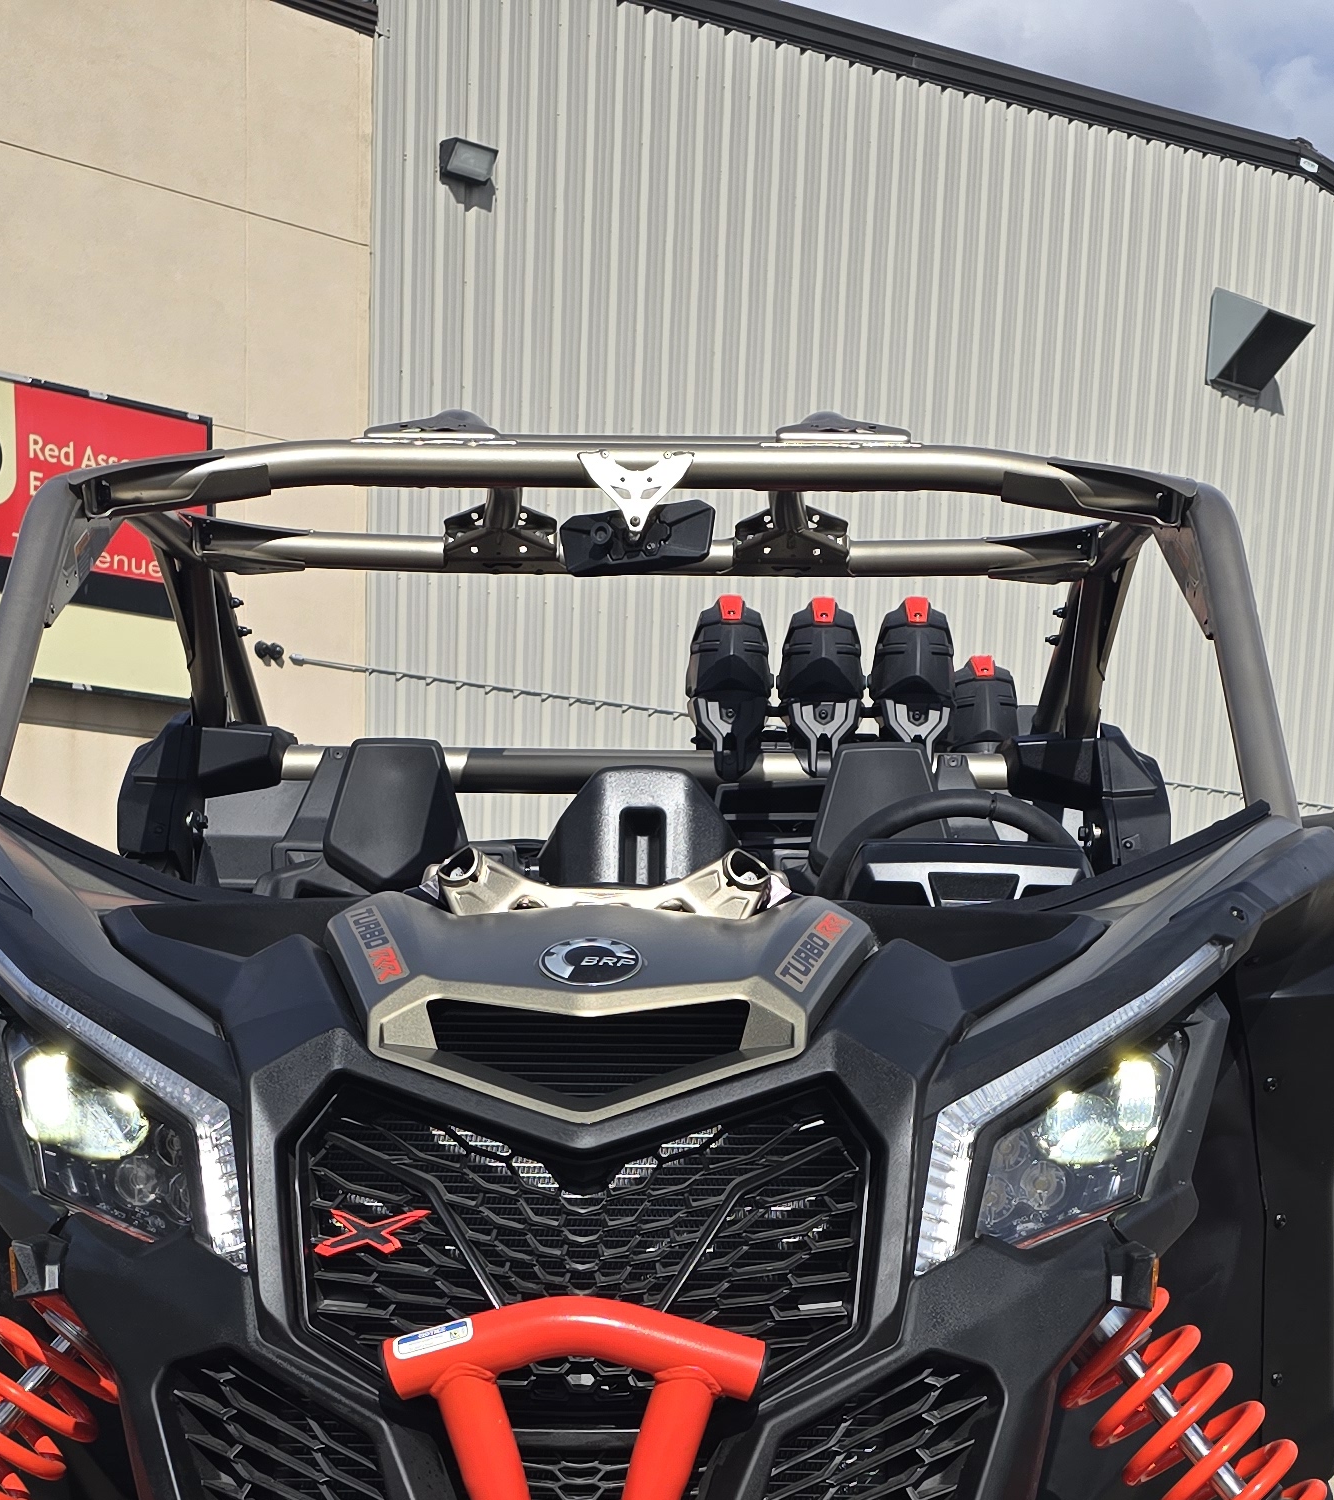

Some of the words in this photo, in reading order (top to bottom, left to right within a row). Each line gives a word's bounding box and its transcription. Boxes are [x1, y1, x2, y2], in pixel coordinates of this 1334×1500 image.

[28, 433, 74, 467] Red
[96, 551, 163, 577] enue
[350, 907, 390, 949] TURBO
[580, 956, 636, 967] BRP
[779, 931, 830, 985] TURBO
